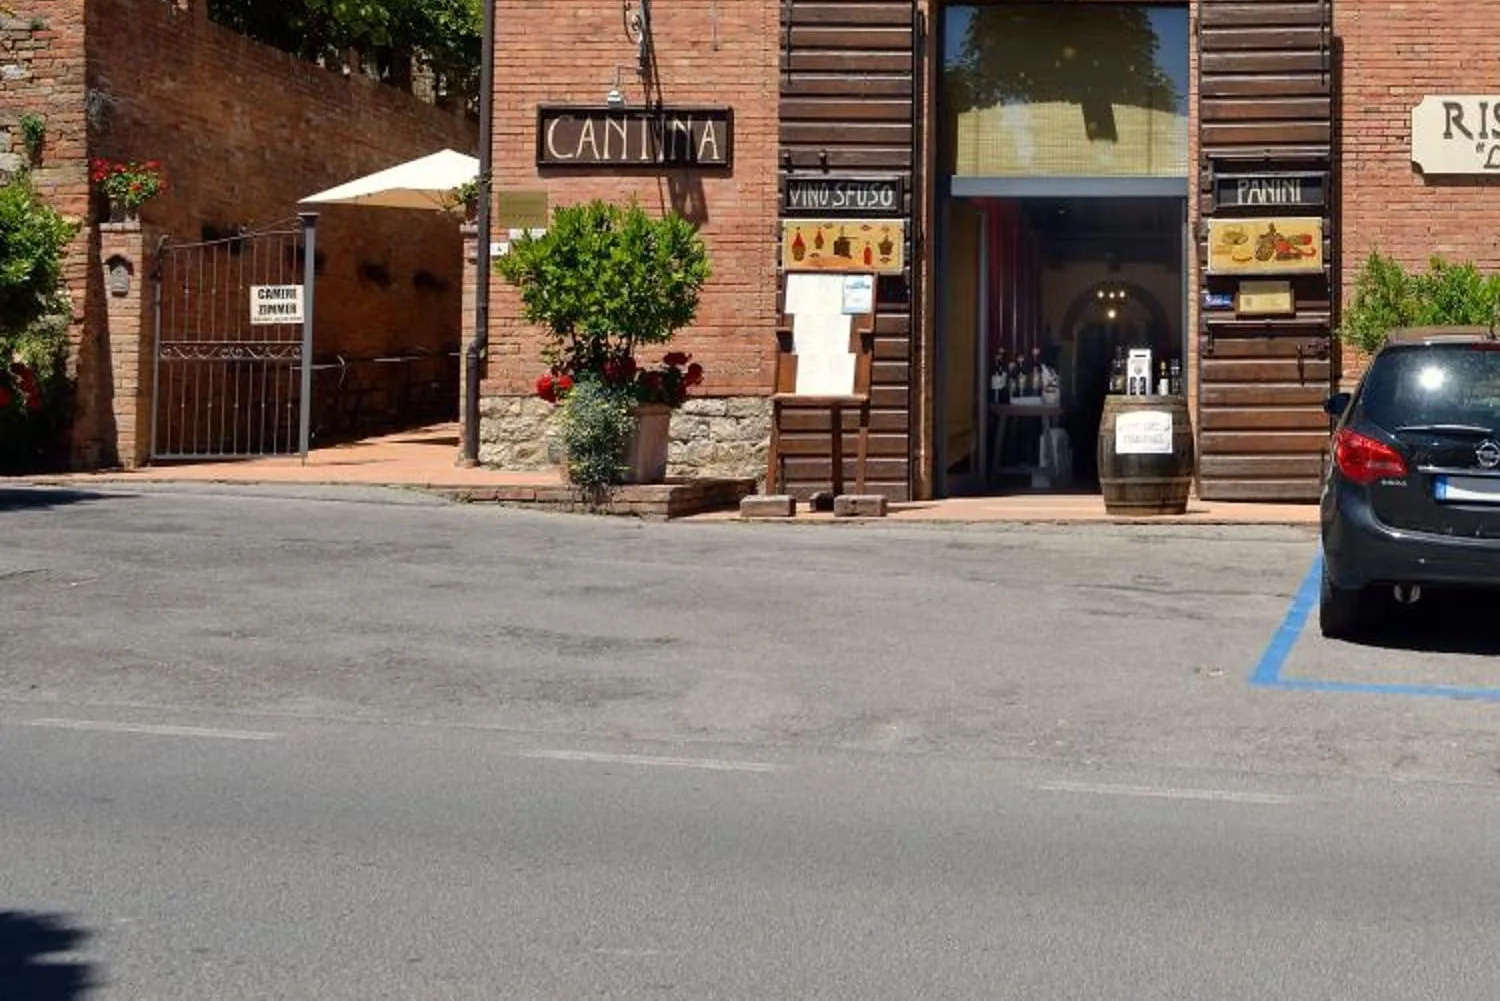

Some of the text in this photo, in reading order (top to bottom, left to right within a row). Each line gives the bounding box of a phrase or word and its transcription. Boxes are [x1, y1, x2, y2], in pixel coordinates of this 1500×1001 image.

[547, 114, 720, 161] CANTINA
[789, 182, 894, 207] VINO SFUSO
[1236, 179, 1301, 205] PANINI
